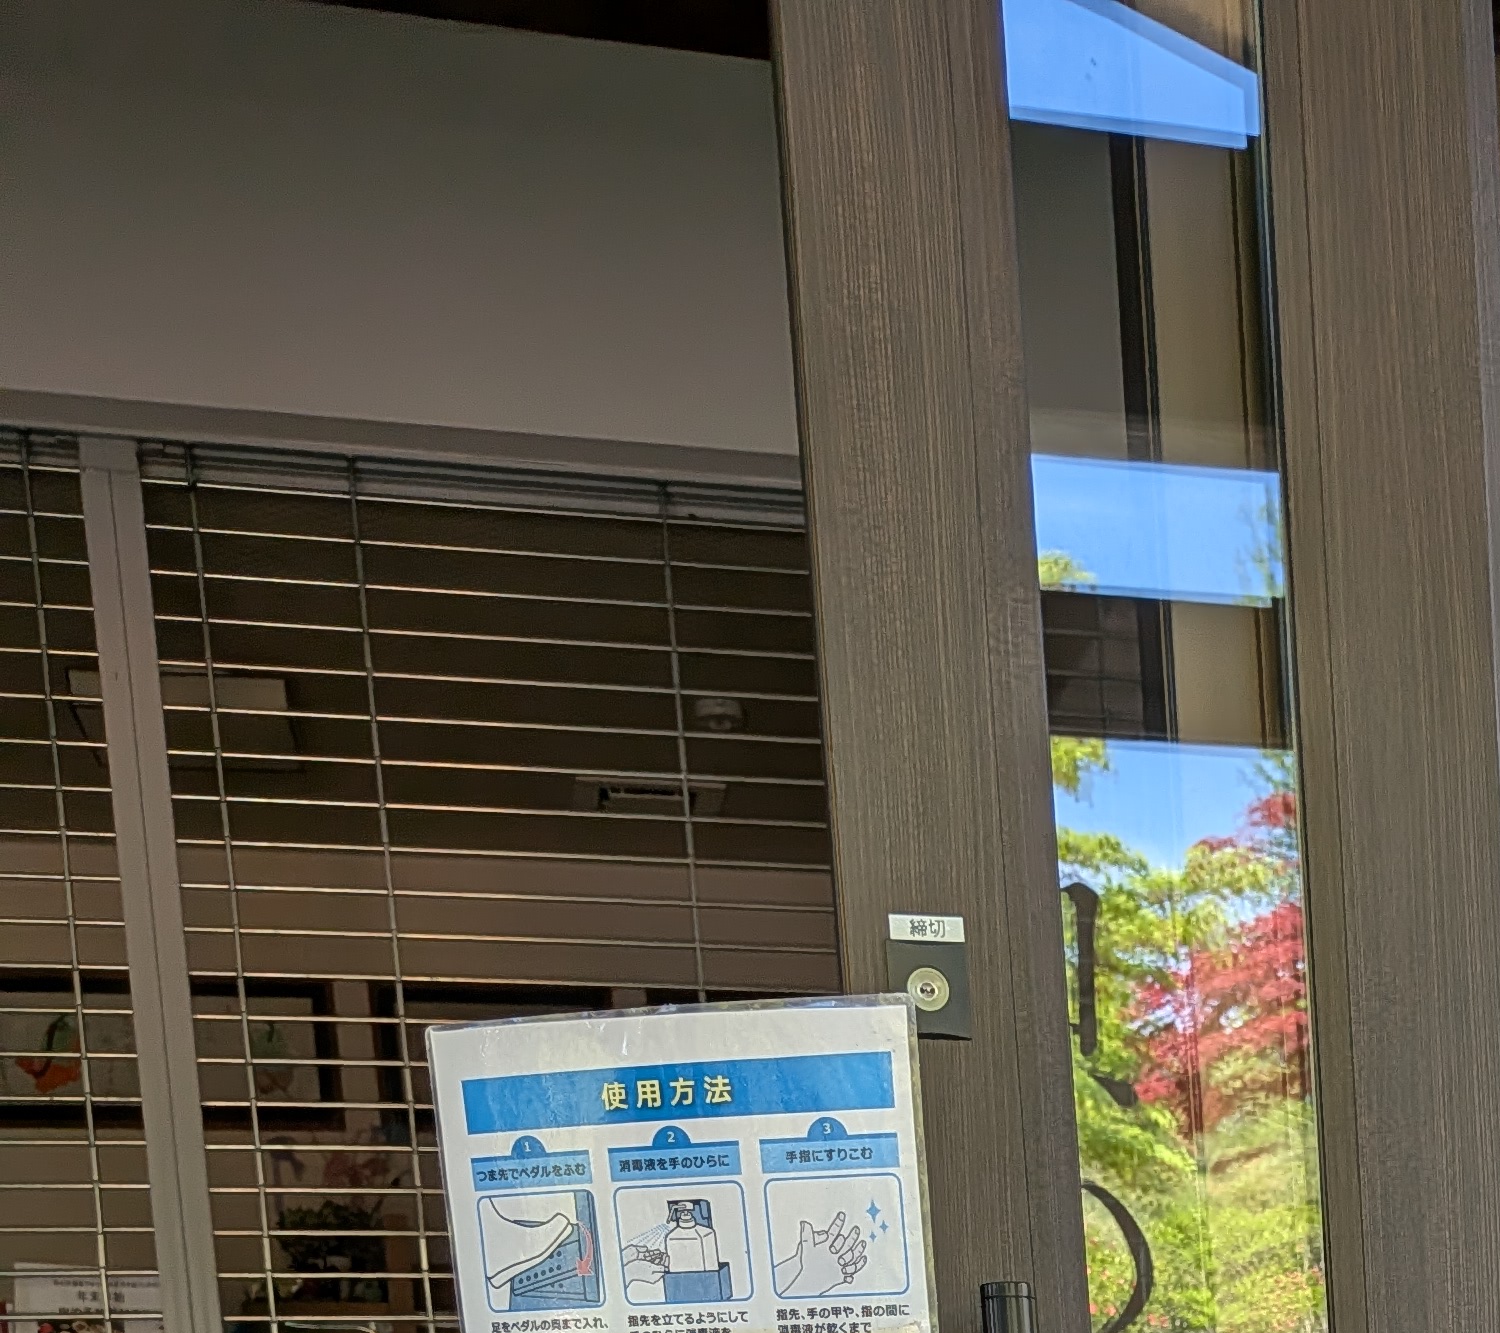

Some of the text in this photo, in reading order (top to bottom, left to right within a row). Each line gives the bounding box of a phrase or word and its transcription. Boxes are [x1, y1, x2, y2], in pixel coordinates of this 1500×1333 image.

[909, 918, 946, 938] 締切
[601, 1075, 732, 1110] 使用方法
[822, 1123, 832, 1134] 3
[619, 1154, 730, 1172] 消毒液を手のひらに
[785, 1147, 874, 1163] 手指にすりこむ
[476, 1163, 587, 1182] つま先でペダルをふむ
[627, 1310, 748, 1327] 指先を立てるようにして
[776, 1303, 910, 1321] 指先、手の甲や、指の間に
